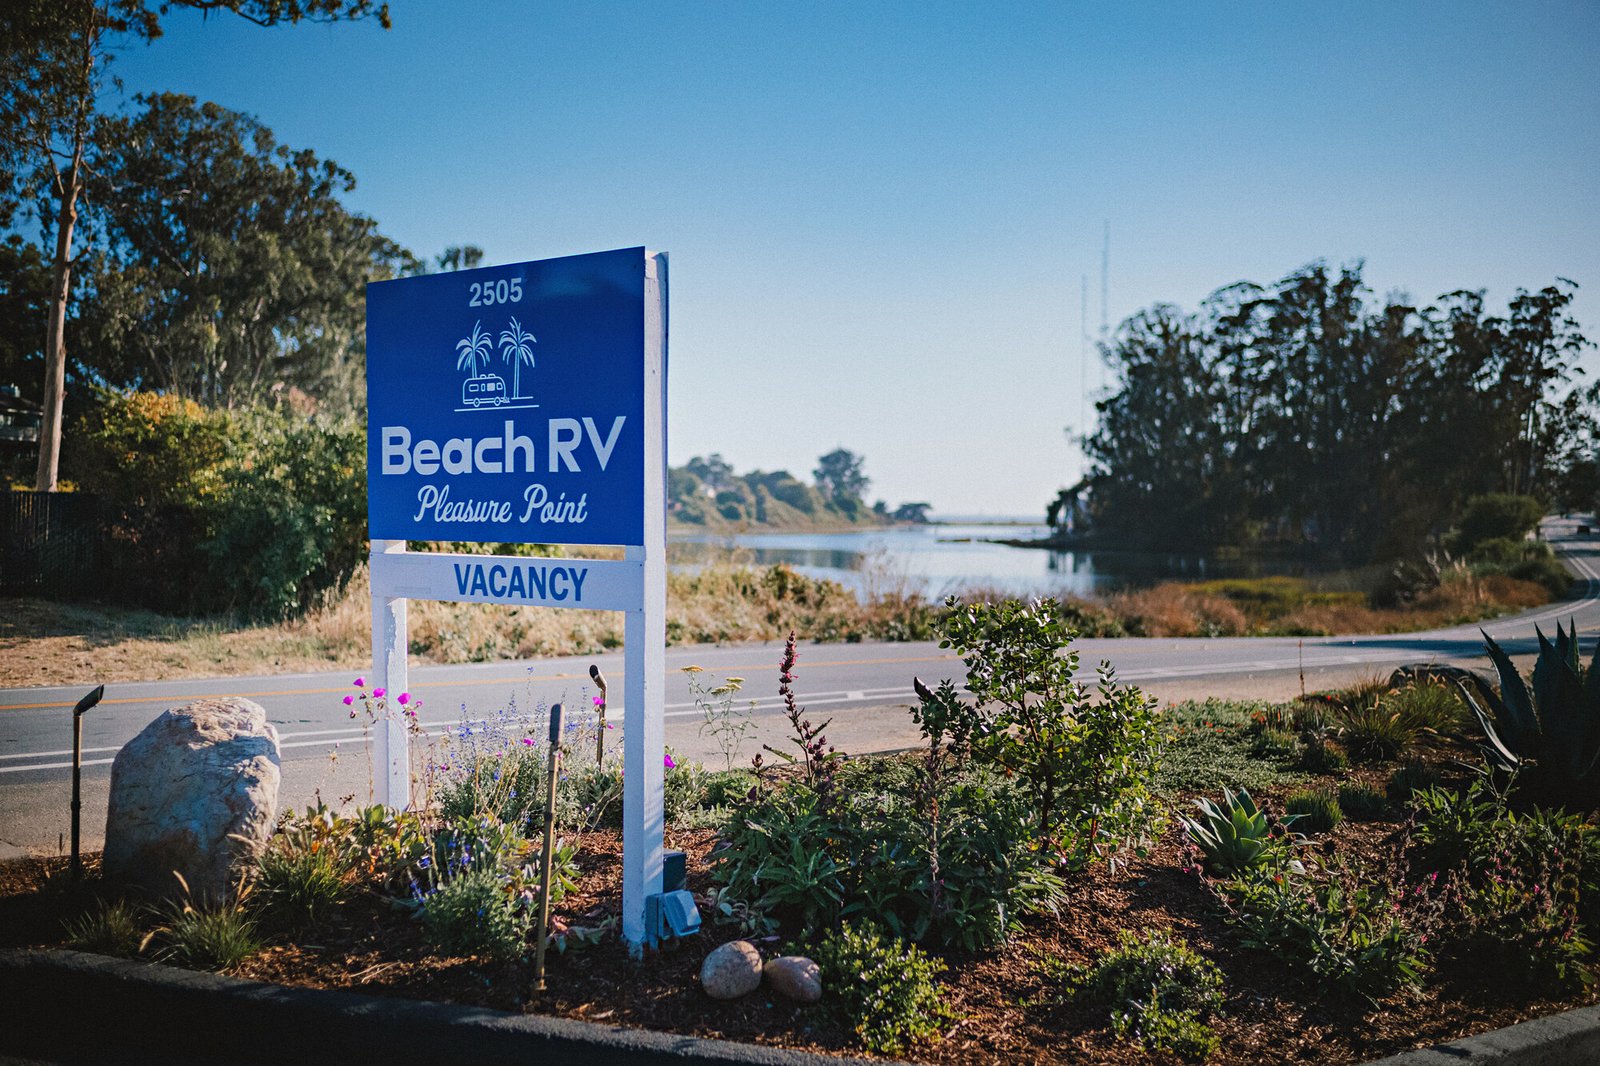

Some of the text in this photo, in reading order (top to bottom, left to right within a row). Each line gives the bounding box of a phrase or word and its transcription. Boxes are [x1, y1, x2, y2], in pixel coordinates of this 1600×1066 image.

[469, 277, 522, 307] 2505
[381, 416, 627, 475] Beach RV
[414, 483, 588, 523] Pleasure Point
[453, 563, 588, 602] VACANCY
